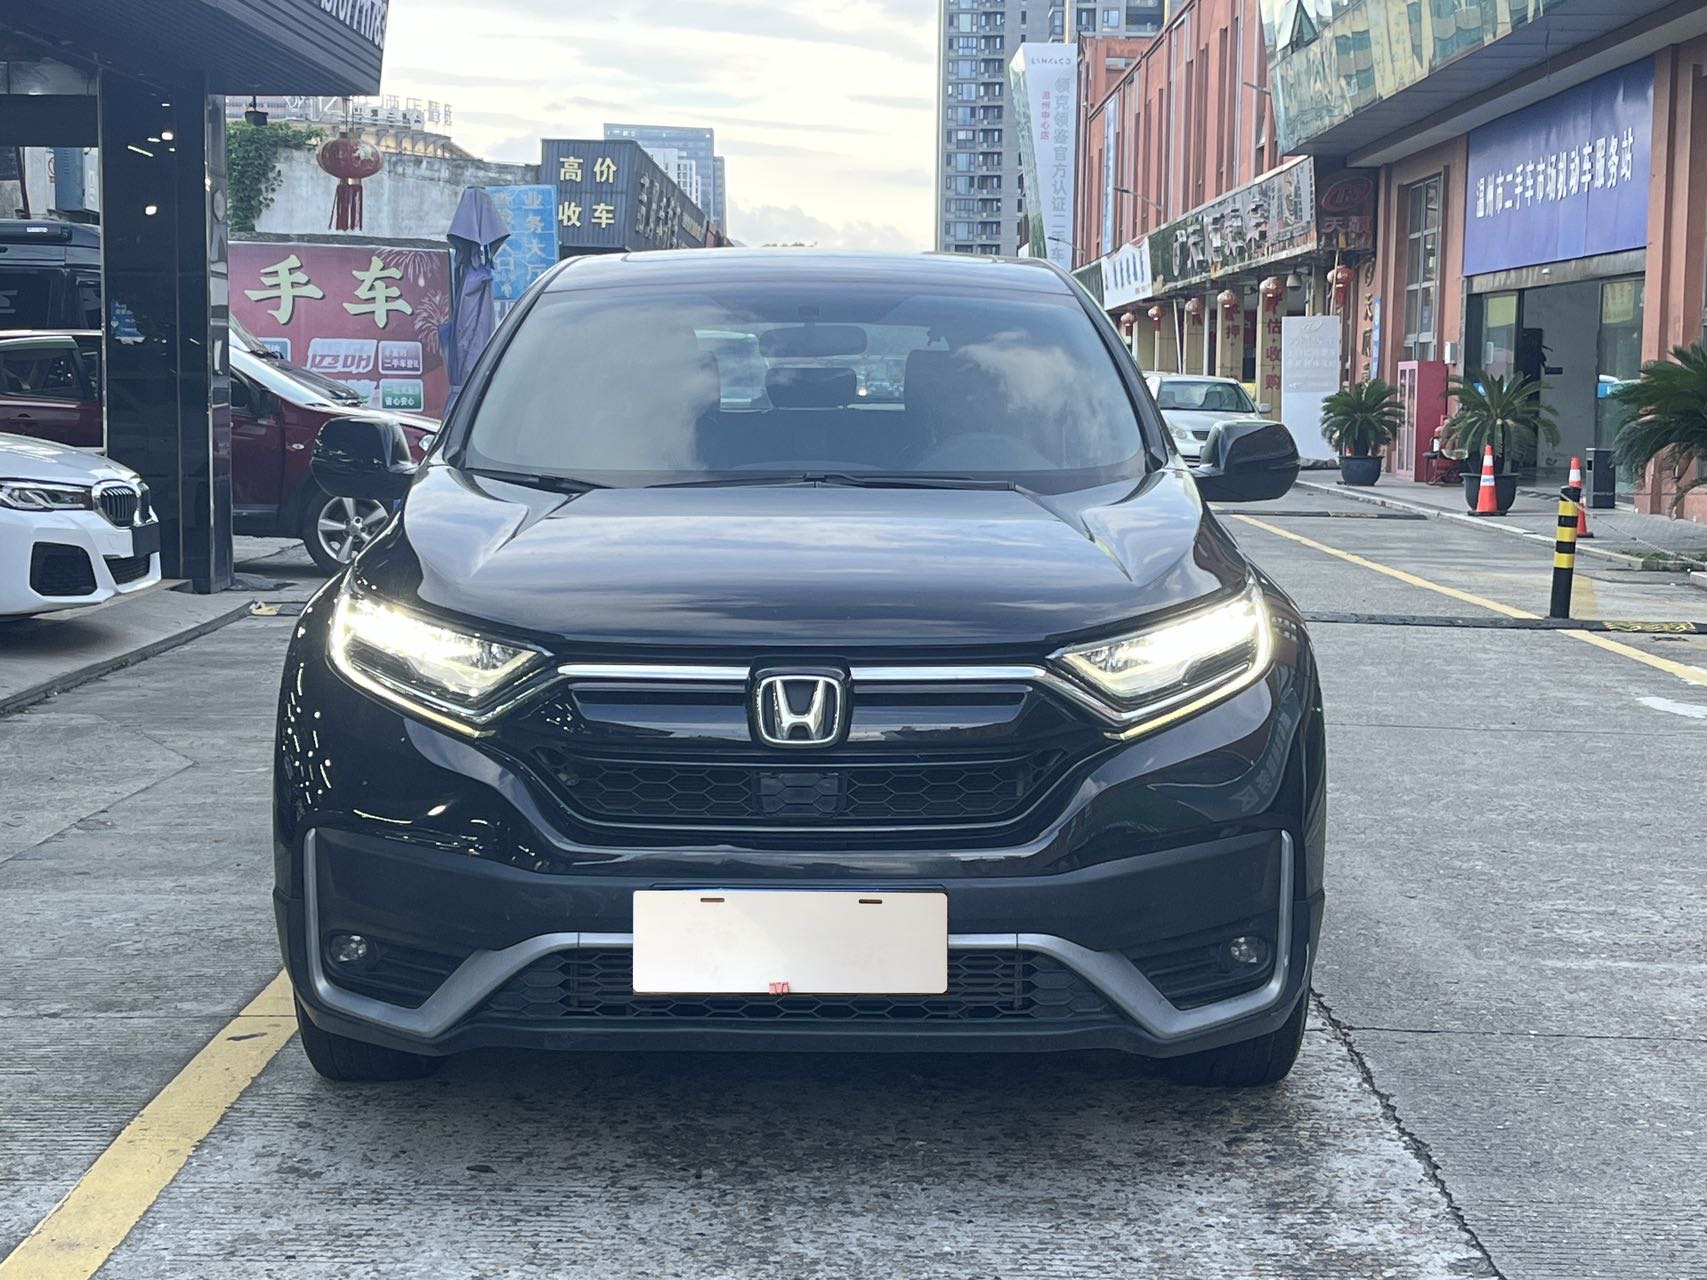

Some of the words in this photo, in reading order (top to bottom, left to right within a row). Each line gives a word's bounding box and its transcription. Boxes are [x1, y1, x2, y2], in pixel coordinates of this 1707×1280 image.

[560, 156, 617, 183] 高价
[1476, 127, 1634, 218] 温州市二手车市场机动车服务站
[558, 201, 615, 228] 收车
